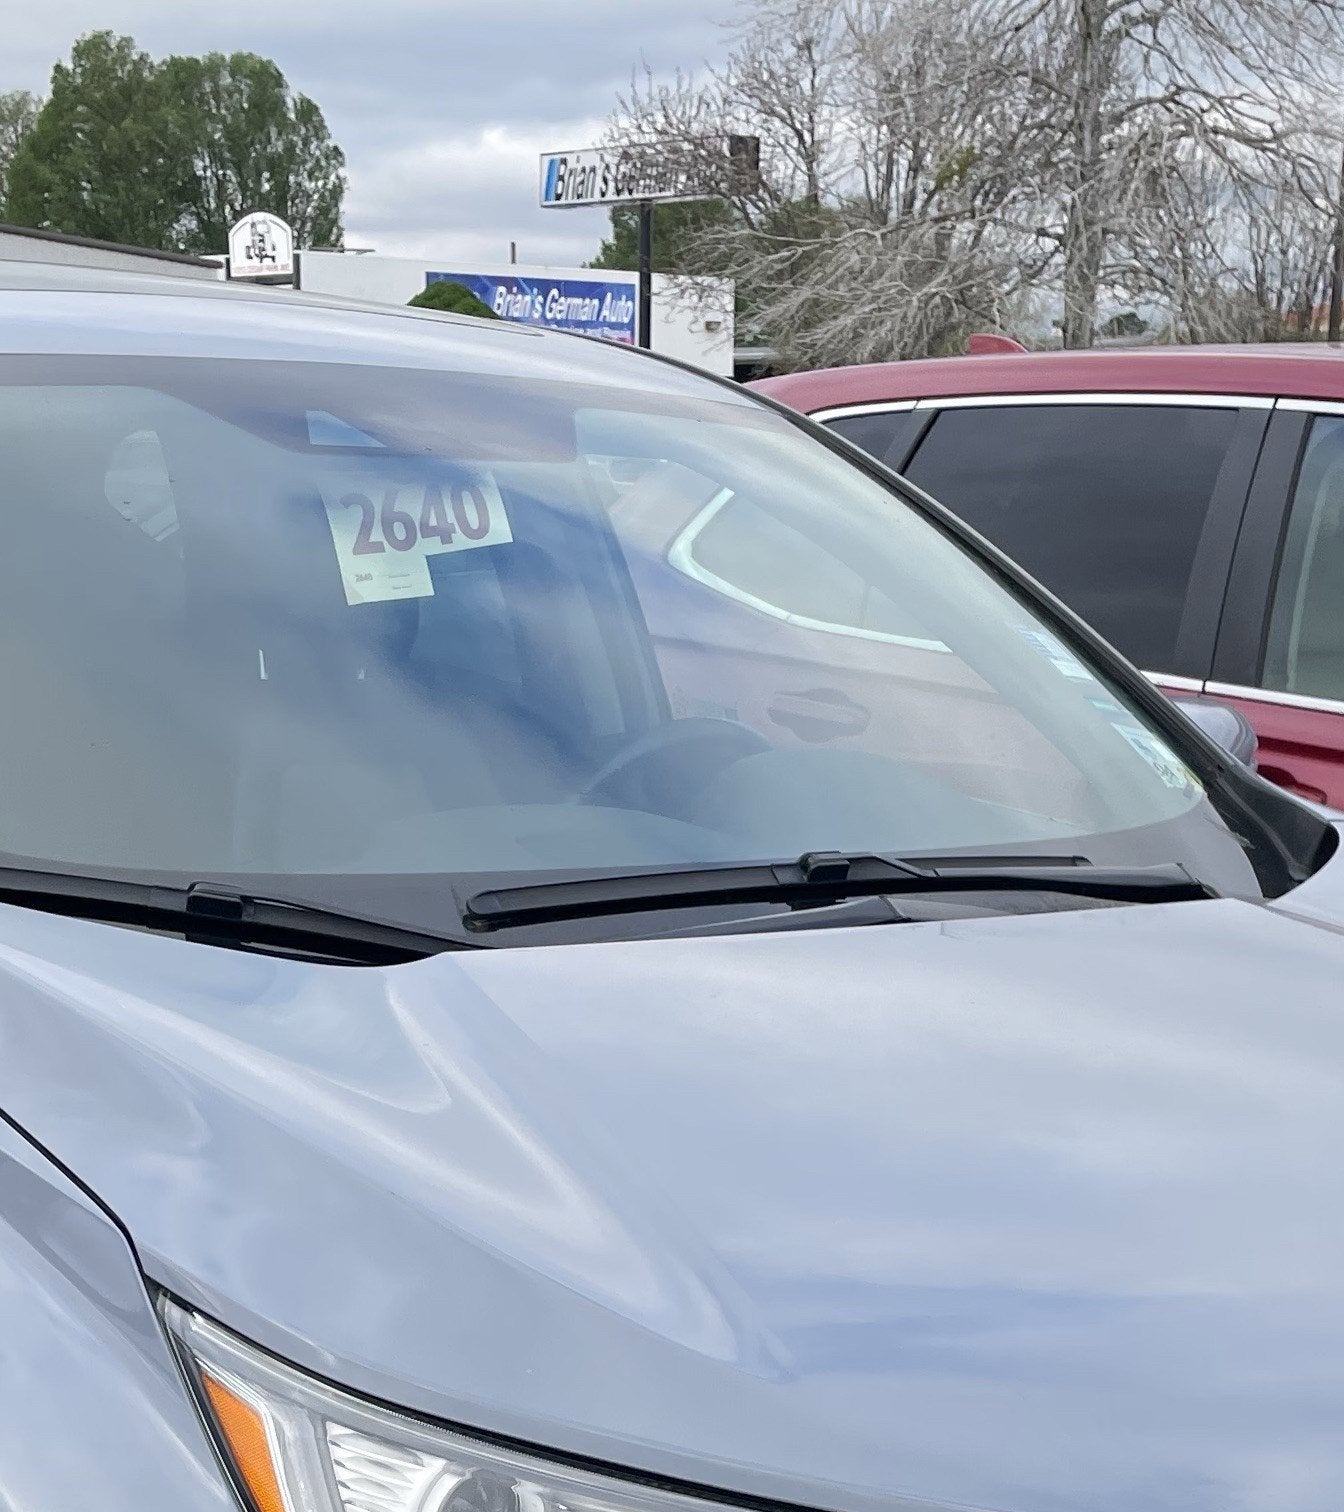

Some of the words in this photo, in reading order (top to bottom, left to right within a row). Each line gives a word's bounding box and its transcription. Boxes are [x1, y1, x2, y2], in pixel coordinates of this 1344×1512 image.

[555, 154, 609, 201] Brian's
[494, 285, 544, 319] Brian's
[545, 287, 599, 321] German
[599, 291, 633, 323] Auto
[340, 482, 491, 556] 2640
